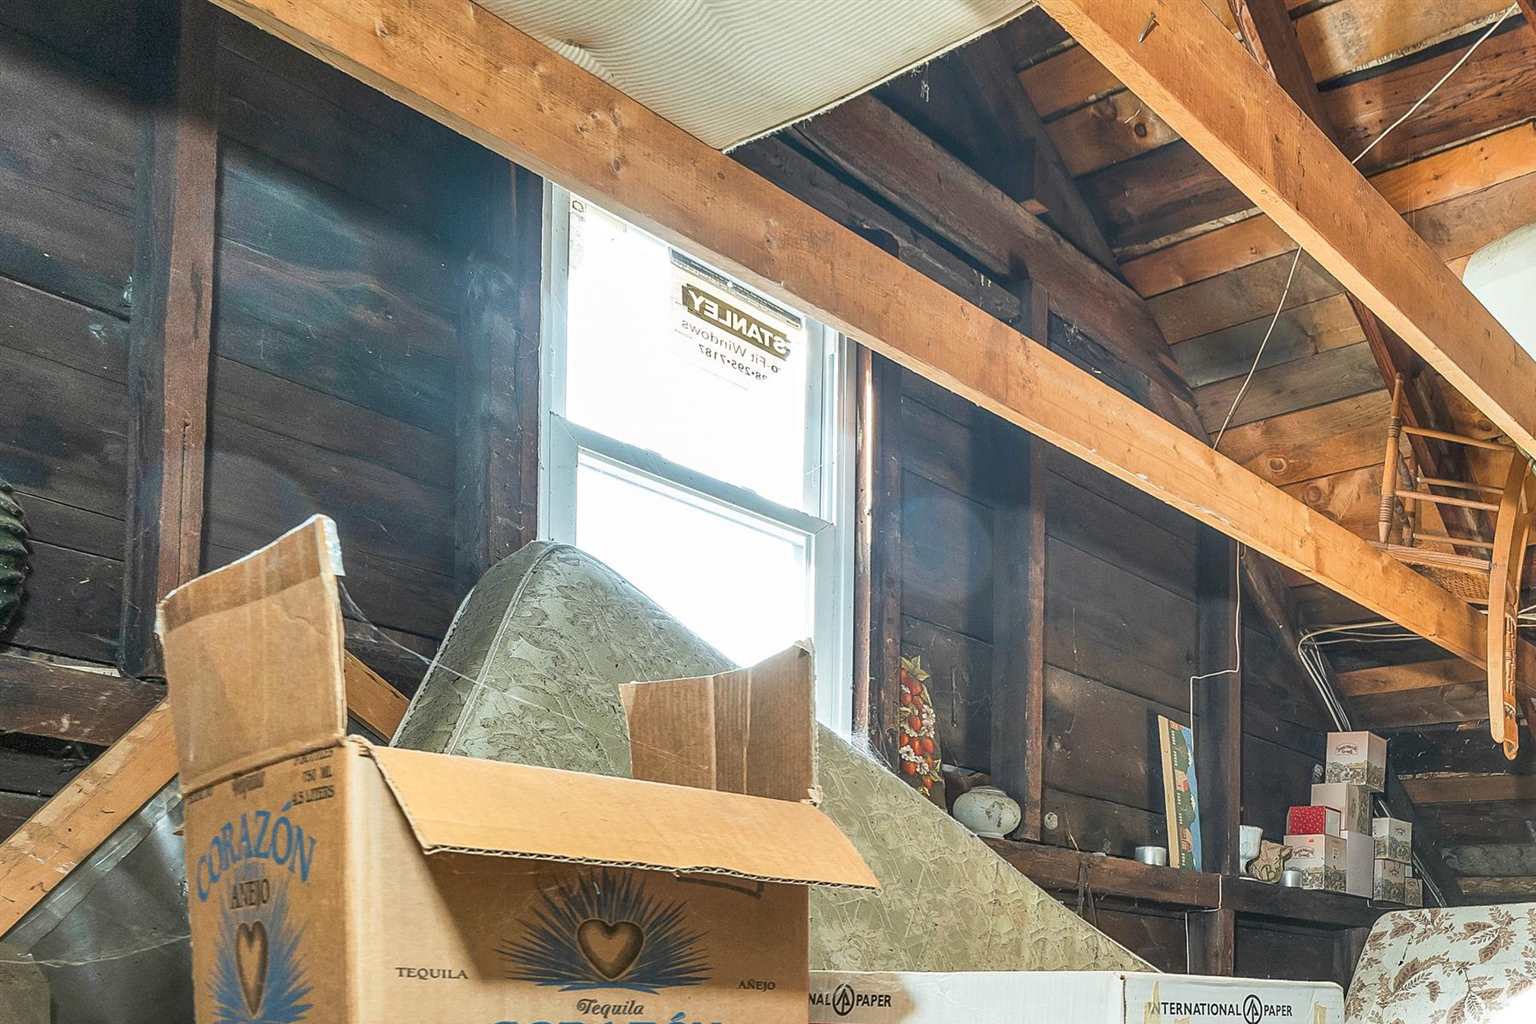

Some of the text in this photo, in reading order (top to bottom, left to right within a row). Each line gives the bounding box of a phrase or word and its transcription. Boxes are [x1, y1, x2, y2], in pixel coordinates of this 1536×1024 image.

[195, 800, 318, 902] CORAZÓN
[395, 966, 469, 981] TEQUILA
[738, 977, 776, 992] AÑEJO
[576, 998, 645, 1018] Tequila
[856, 994, 892, 1008] PAPER
[1264, 1004, 1293, 1018] PAPER
